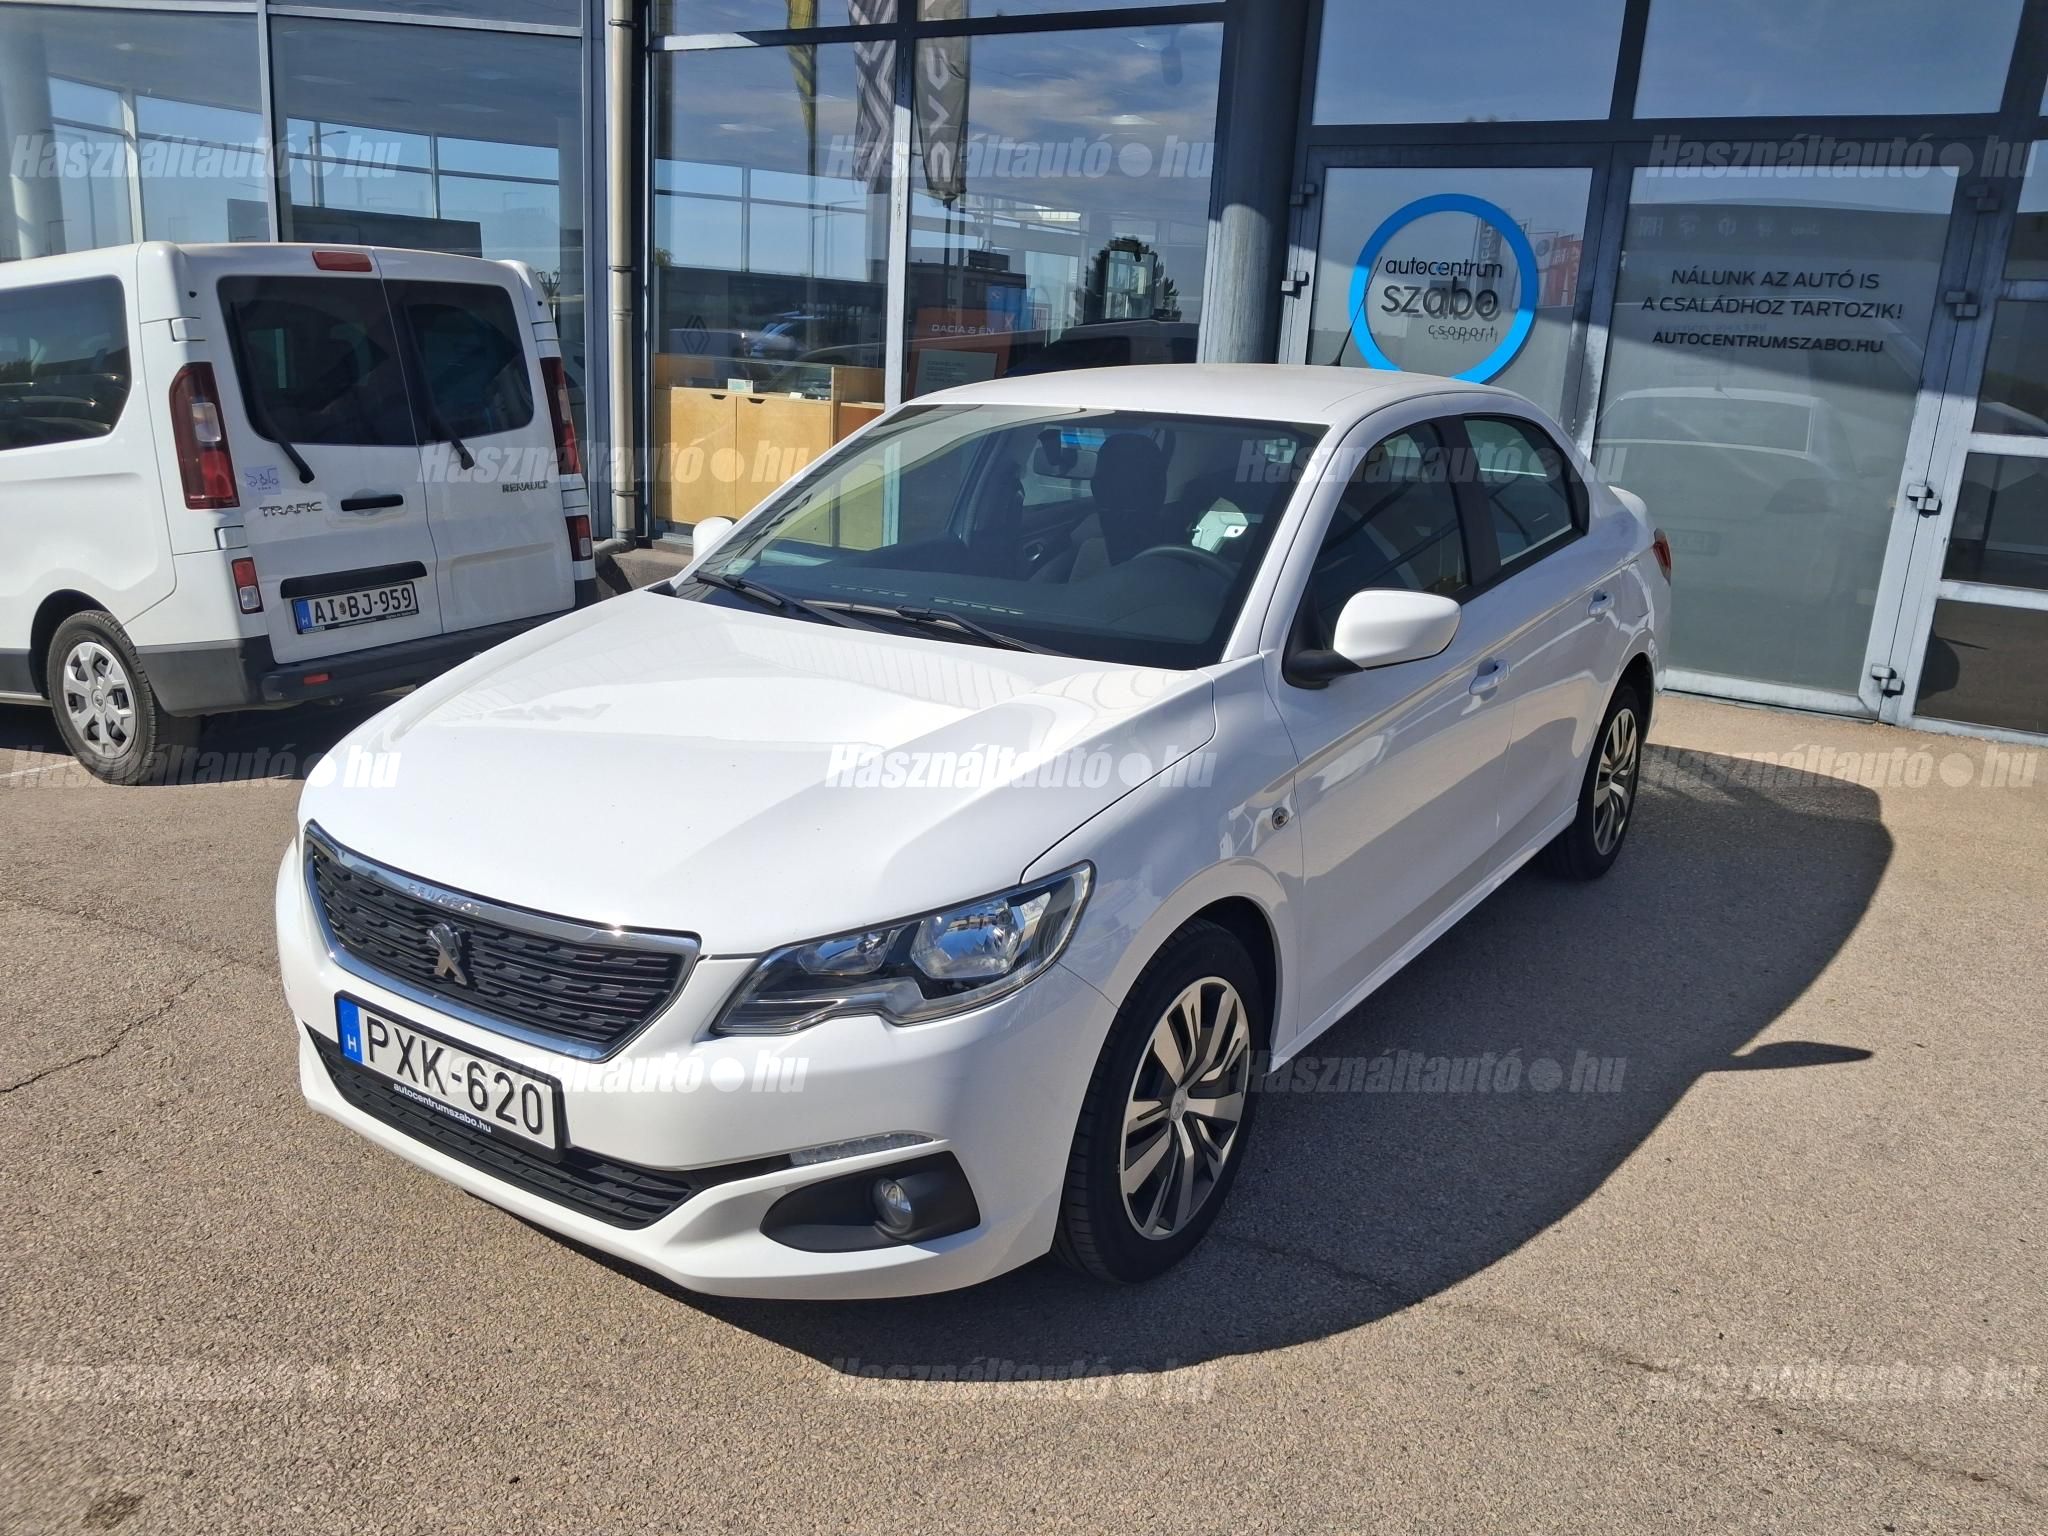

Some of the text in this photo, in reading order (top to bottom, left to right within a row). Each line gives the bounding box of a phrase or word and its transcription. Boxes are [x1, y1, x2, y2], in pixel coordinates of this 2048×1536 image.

[1385, 257, 1503, 278] autocentrum
[1671, 266, 1880, 289] NÁLUNK AZ AUTÓ IS
[1381, 277, 1498, 317] szabo
[1641, 295, 1904, 319] A CSALÁDHOZ TARTOZIK!
[931, 323, 966, 334] DACIA
[1428, 324, 1495, 339] csoport
[1652, 331, 1884, 353] AUTOCENTRUMSZABO.HU
[502, 480, 548, 493] RENAULT
[259, 502, 323, 518] TRAFIC
[346, 1033, 358, 1053] H
[366, 1015, 544, 1136] PXK-620
[393, 1082, 493, 1134] autocentrumszabo.hu
